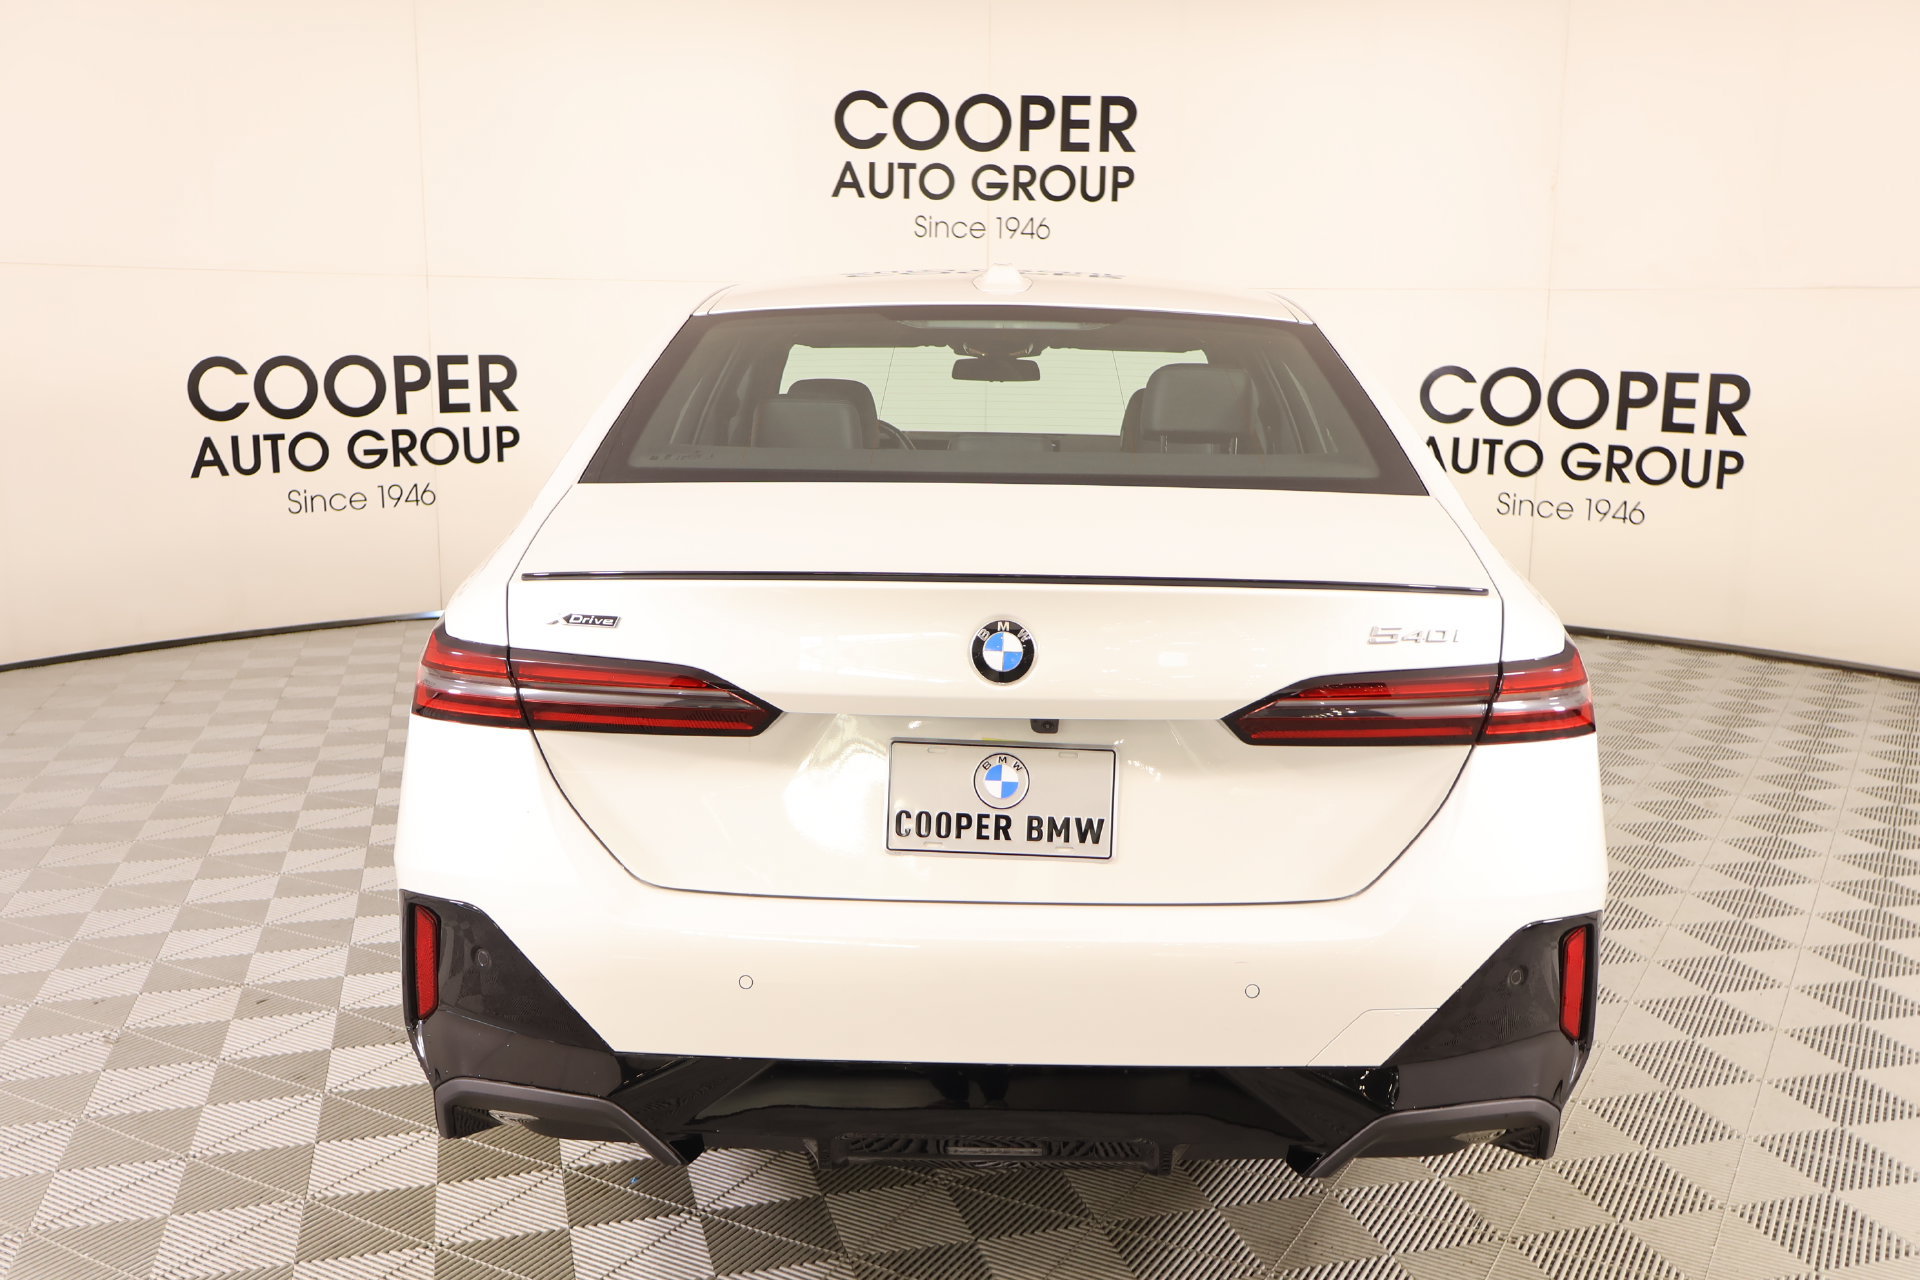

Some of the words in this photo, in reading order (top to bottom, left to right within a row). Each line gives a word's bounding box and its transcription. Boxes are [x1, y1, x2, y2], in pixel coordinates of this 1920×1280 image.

[834, 90, 1138, 152] COOPER
[831, 160, 956, 201] AUTO
[971, 163, 1136, 203] GROUP
[914, 214, 987, 239] Since
[995, 216, 1051, 240] 1946
[187, 354, 519, 422] COOPER
[1419, 365, 1751, 437] COOPER
[190, 431, 330, 479] AUTO
[347, 425, 521, 470] GROUP
[1560, 442, 1745, 490] GROUP
[287, 488, 368, 514] Since
[377, 482, 437, 509] 1946
[1496, 492, 1574, 520] Since
[1585, 498, 1646, 525] 1946
[977, 621, 1032, 642] BMW
[981, 755, 1023, 771] BMW
[895, 809, 1012, 841] COOPER
[1026, 815, 1105, 845] BMW
